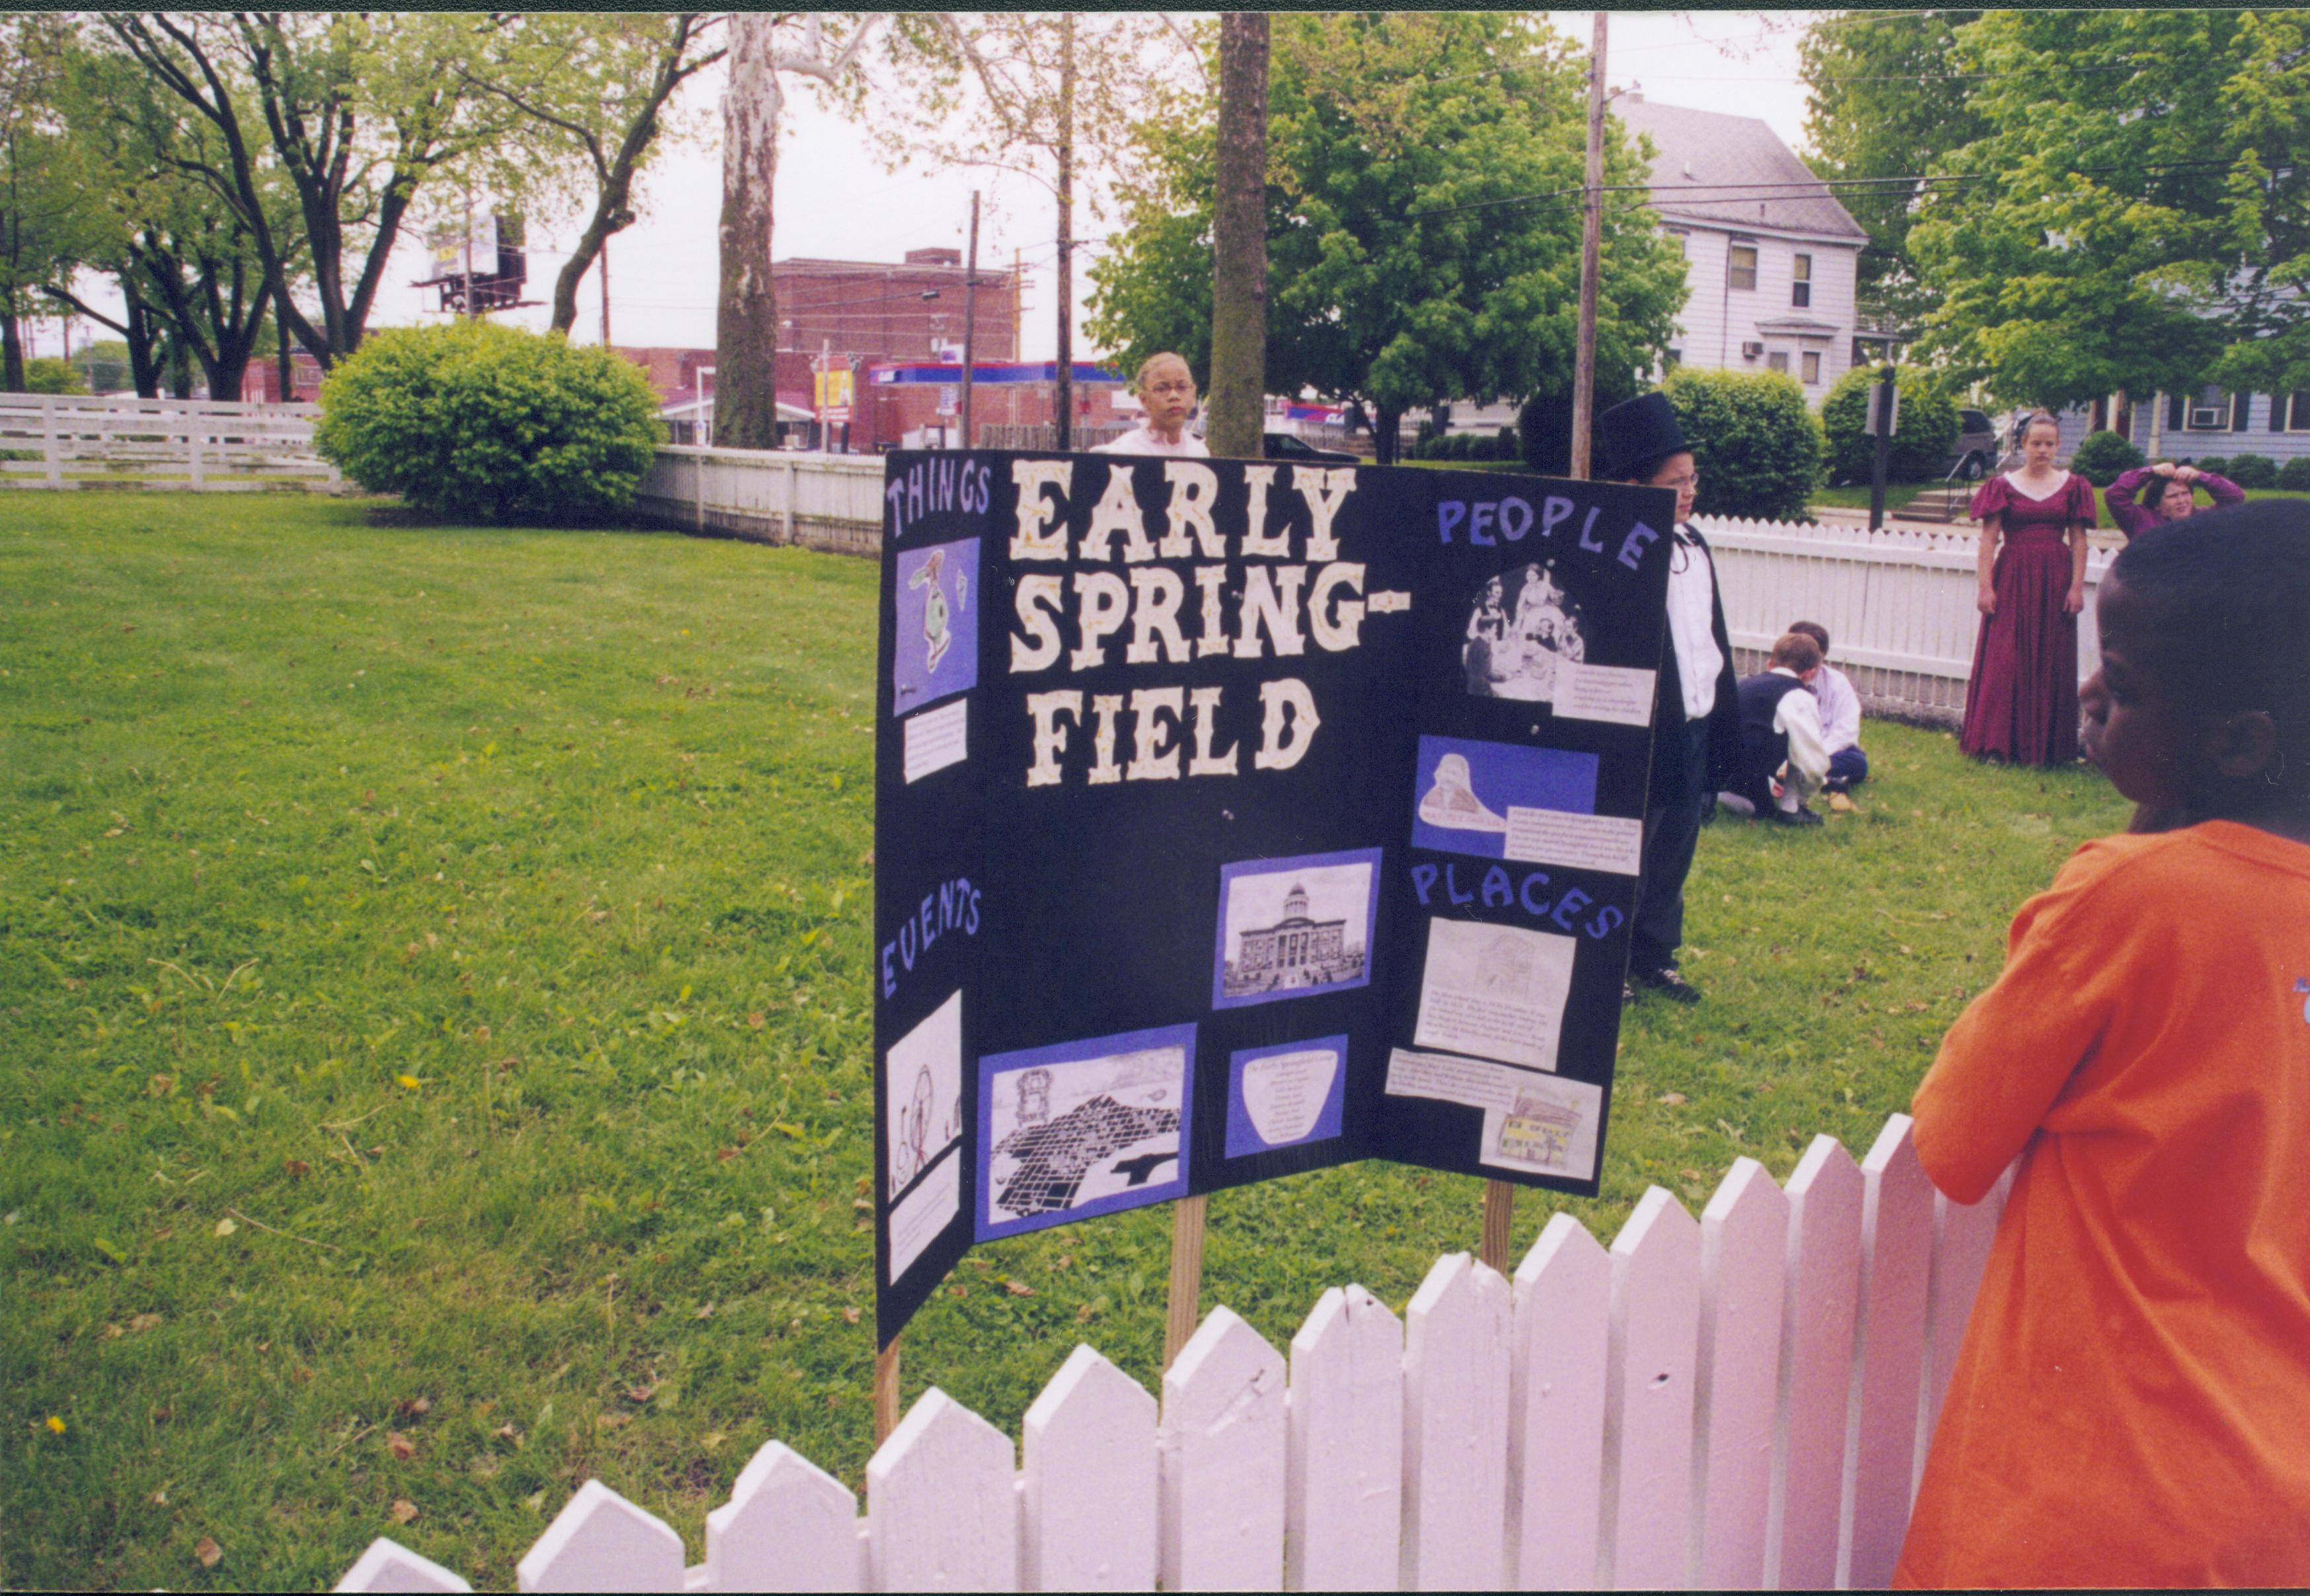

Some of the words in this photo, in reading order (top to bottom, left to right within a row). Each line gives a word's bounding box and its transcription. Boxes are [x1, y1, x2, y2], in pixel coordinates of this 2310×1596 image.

[886, 458, 992, 538] THINGS
[1008, 459, 1357, 563] EARLY
[1437, 495, 1659, 571] PEOPLE
[1009, 561, 1411, 674] SPRING-
[1026, 677, 1321, 787] FIELD
[1411, 862, 1623, 939] PLACES
